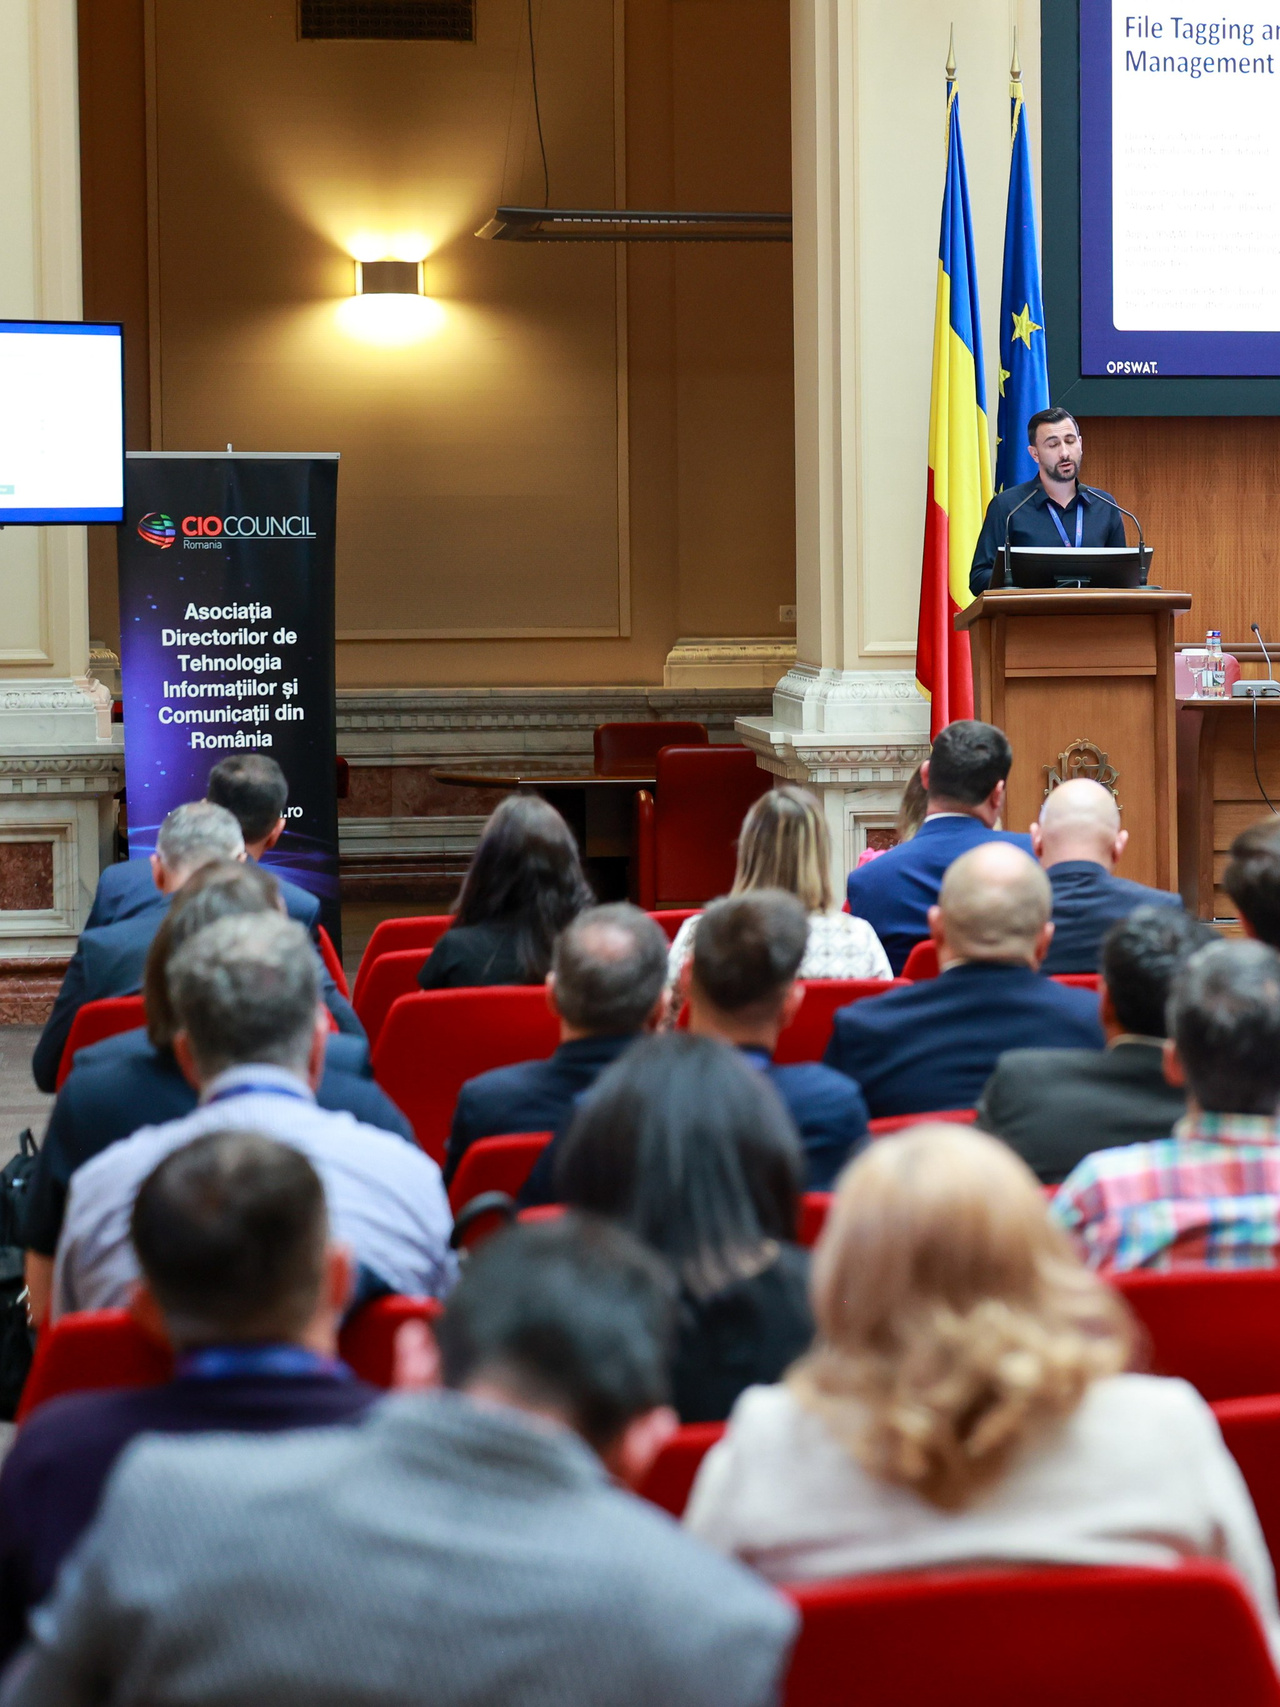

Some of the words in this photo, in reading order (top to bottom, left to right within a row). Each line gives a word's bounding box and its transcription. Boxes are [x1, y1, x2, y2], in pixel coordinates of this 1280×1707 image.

[1125, 15, 1163, 39] File
[1170, 16, 1255, 47] Tagging
[1125, 50, 1275, 79] Management
[183, 539, 223, 549] Romania
[184, 602, 272, 624] Asociația
[161, 627, 269, 646] Directorilor
[273, 627, 298, 645] de
[177, 653, 282, 674] Tehnologia
[163, 679, 278, 701] Informațiilor
[282, 678, 298, 701] și
[158, 704, 269, 726] Comunicații
[275, 703, 304, 721] din
[191, 730, 273, 749] România
